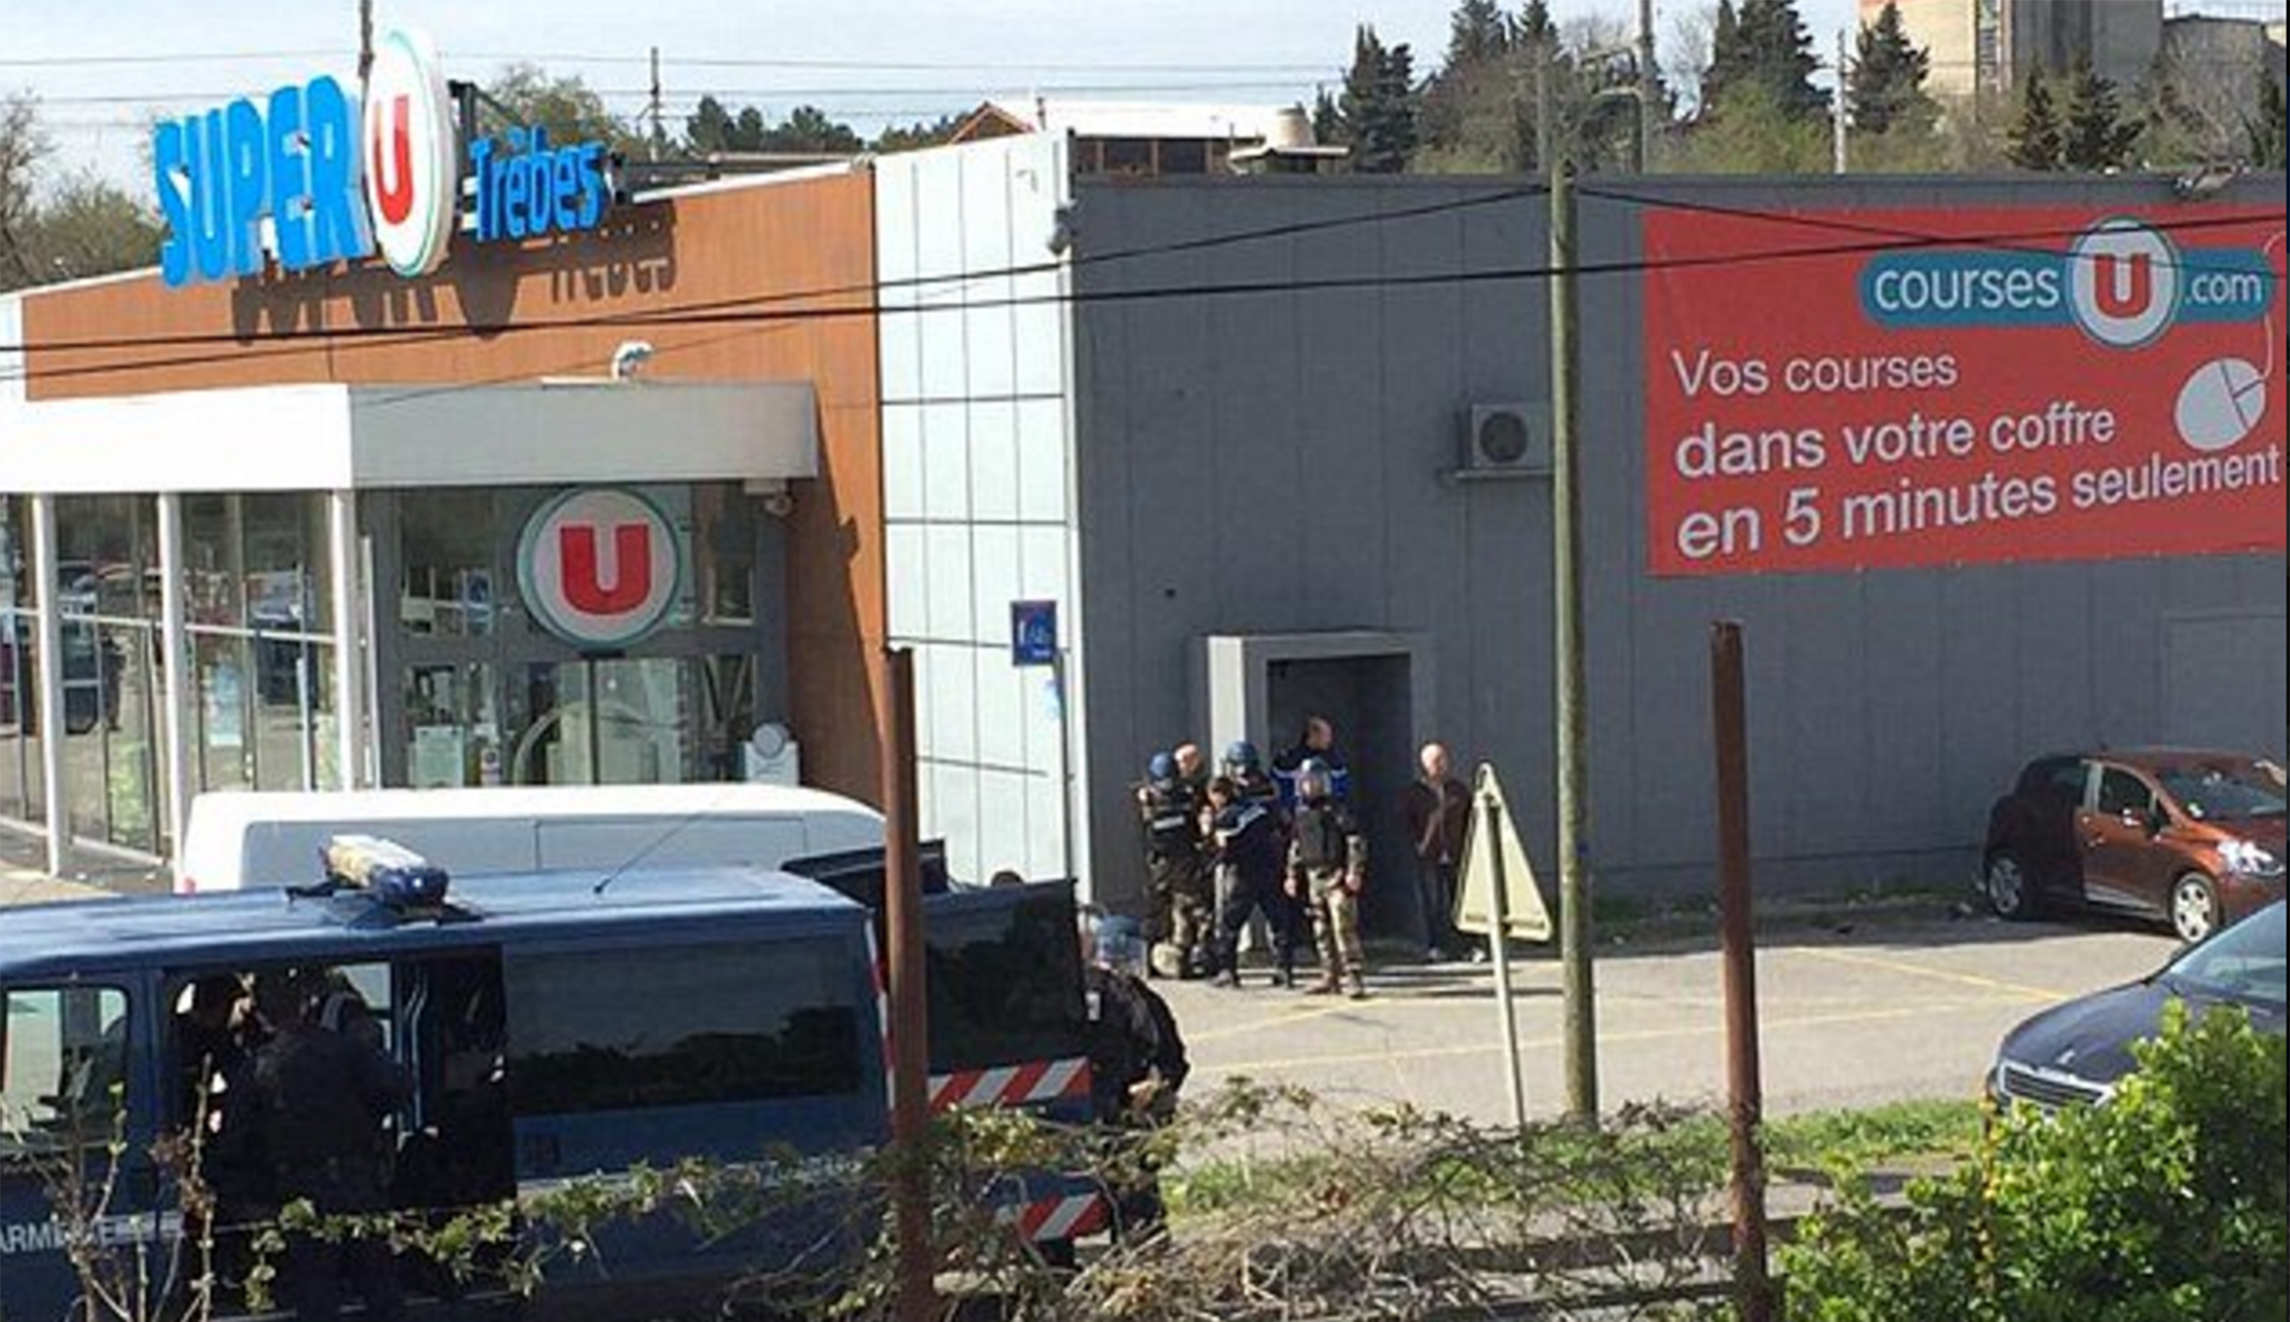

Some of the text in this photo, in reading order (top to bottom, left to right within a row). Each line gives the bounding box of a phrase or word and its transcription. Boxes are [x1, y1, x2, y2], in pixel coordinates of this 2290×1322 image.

[155, 75, 364, 287] SUPER
[371, 95, 414, 225] U
[1874, 255, 2263, 317] courses U .com
[1672, 350, 1958, 395] Vos courses
[1676, 402, 2117, 478] dans votre coffre
[1677, 443, 2281, 560] en 5 minutes seulement
[560, 524, 650, 614] U
